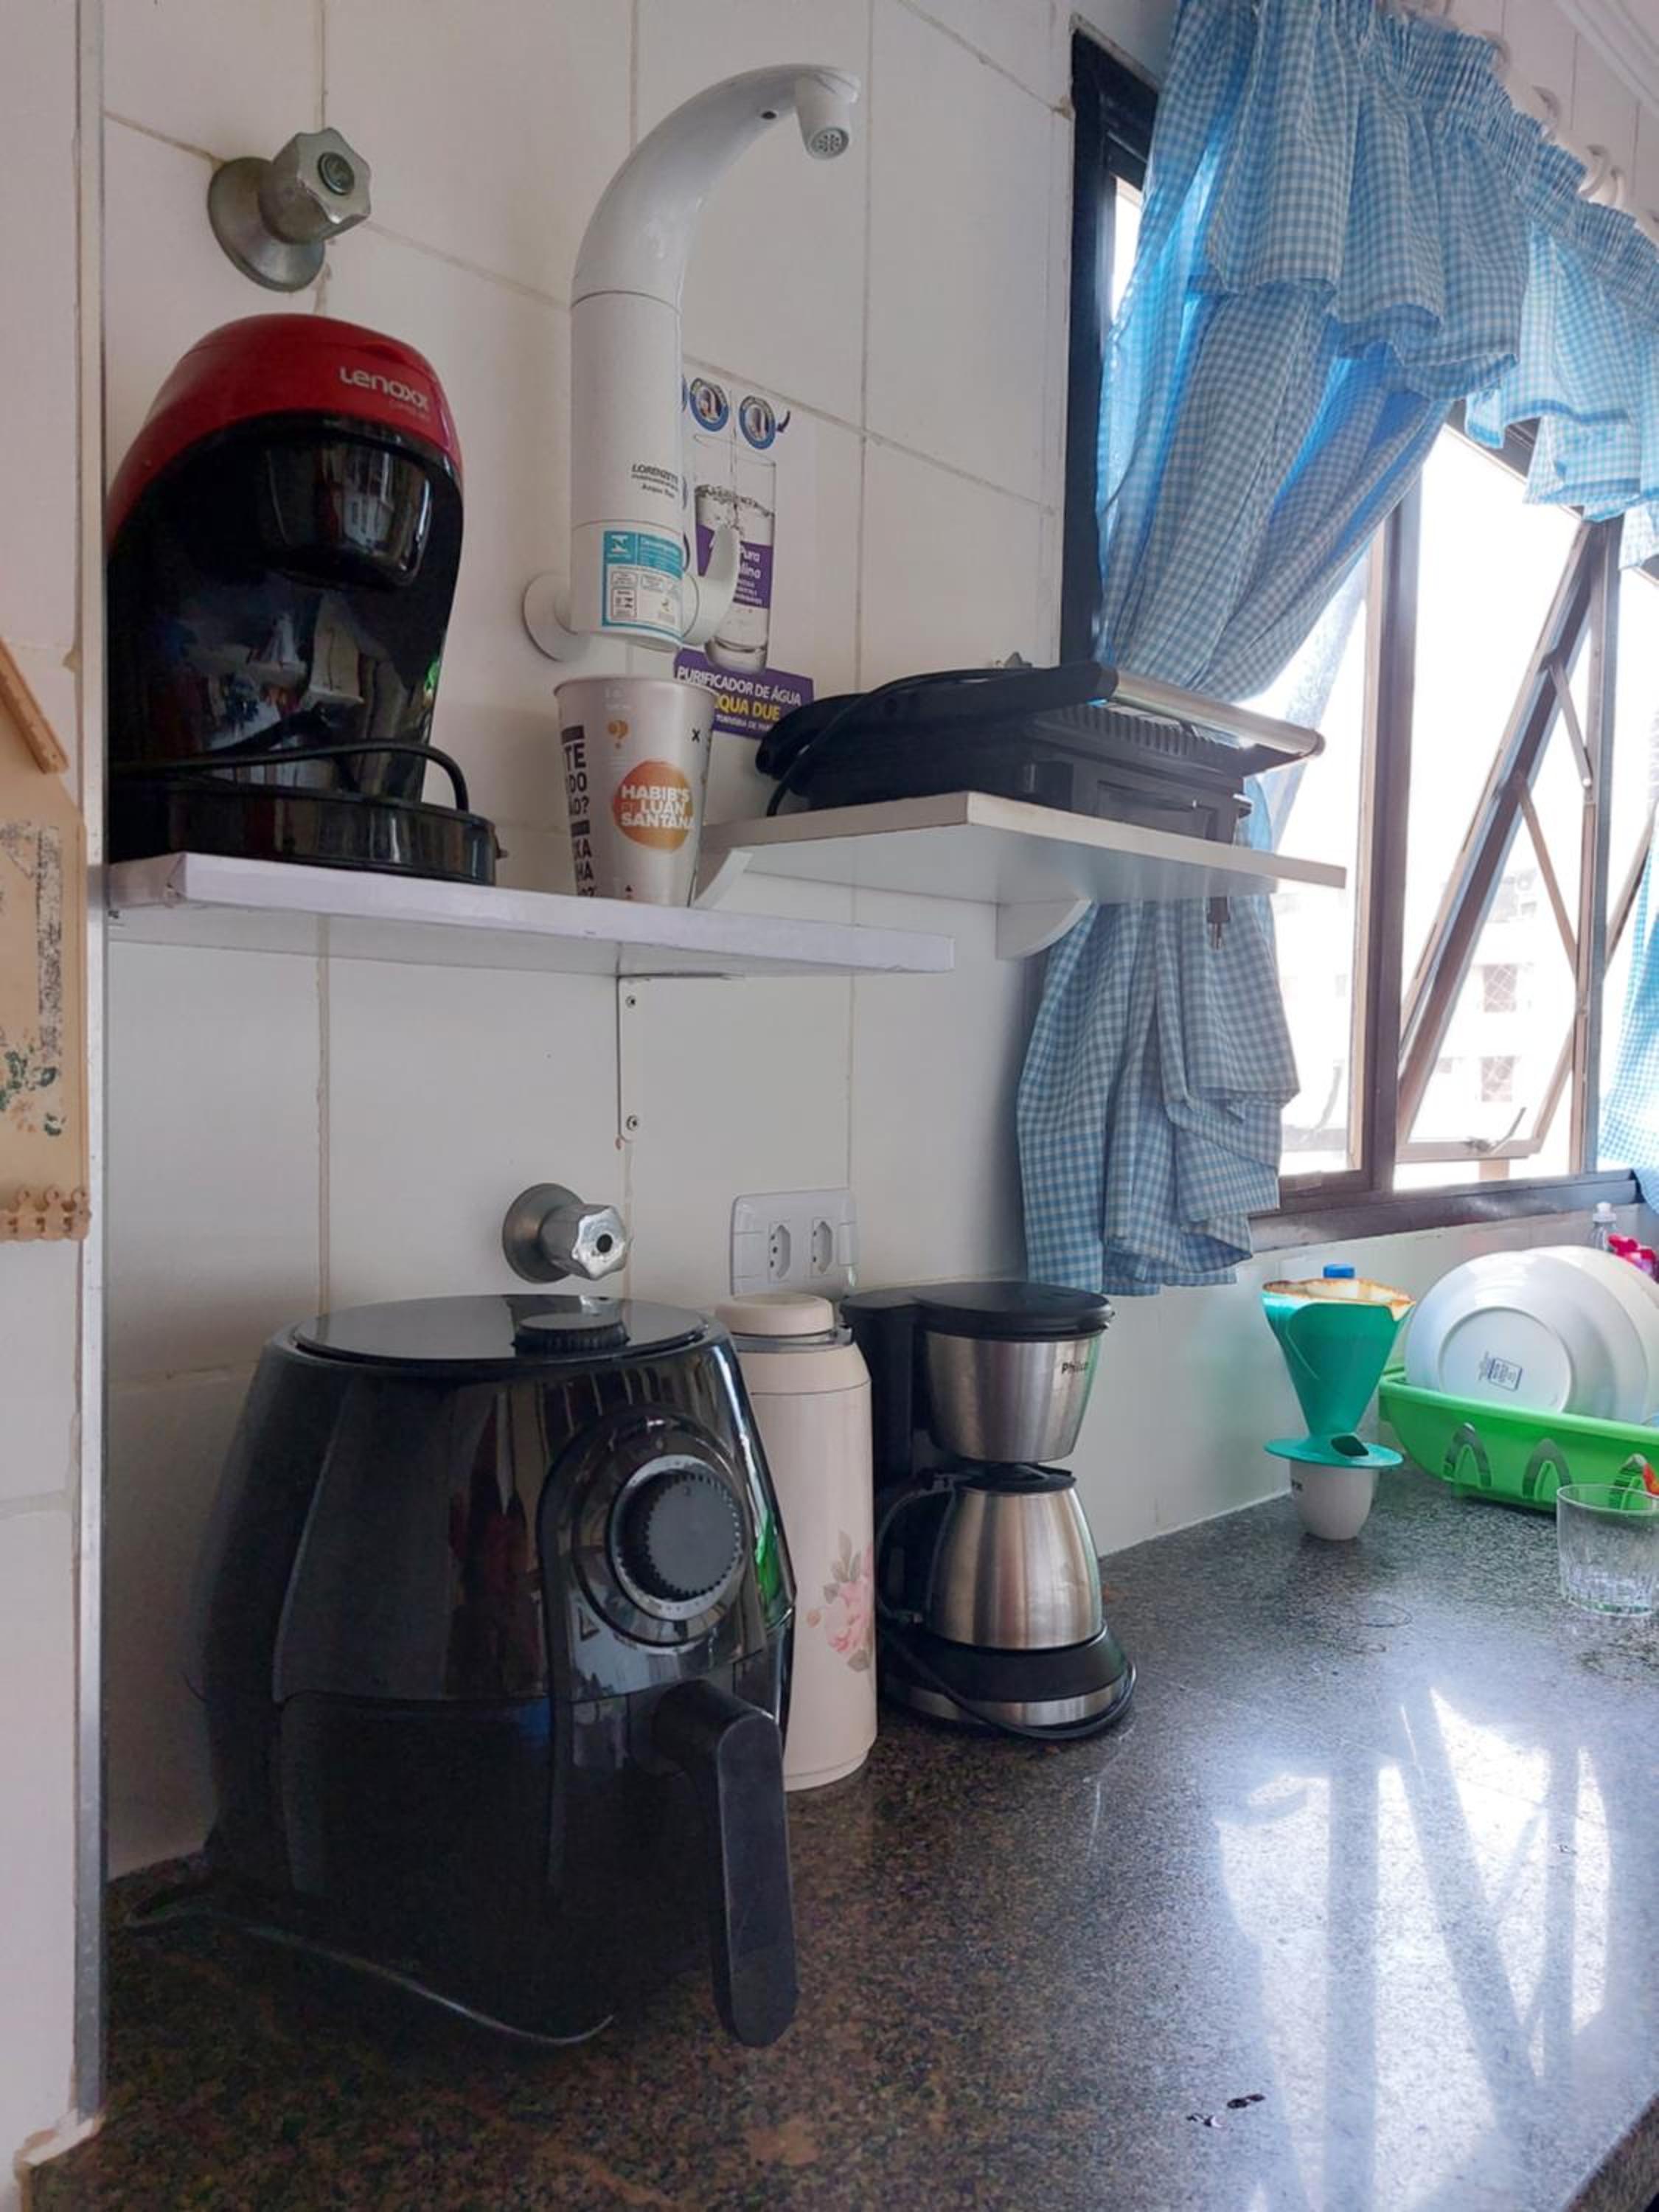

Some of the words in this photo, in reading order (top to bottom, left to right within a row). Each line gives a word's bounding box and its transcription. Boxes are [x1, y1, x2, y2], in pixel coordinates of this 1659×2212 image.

[677, 666, 754, 695] PURIFICADOR
[755, 684, 771, 699] DE
[771, 685, 801, 706] ÁGUA
[714, 694, 748, 716] QUA
[752, 700, 780, 721] DUE
[621, 785, 690, 802] HABIB'S
[640, 800, 685, 815] LUAN
